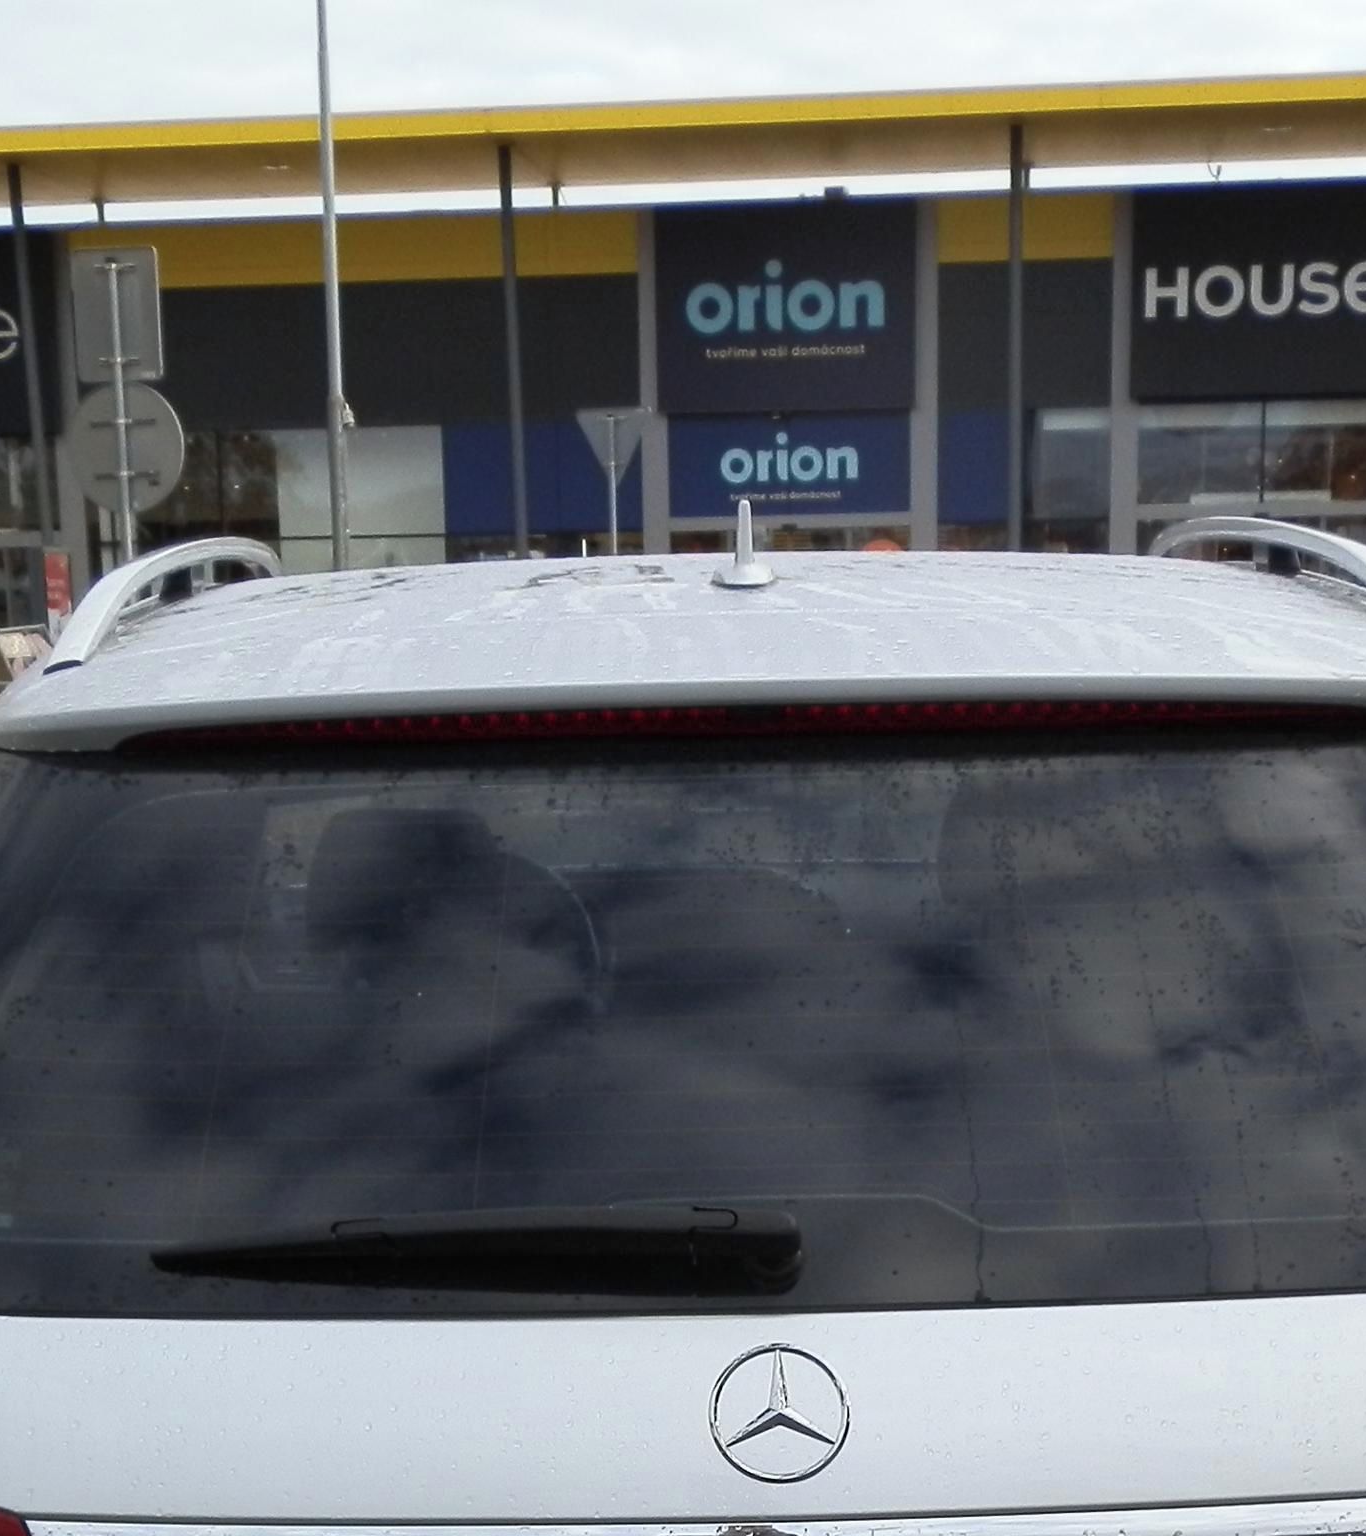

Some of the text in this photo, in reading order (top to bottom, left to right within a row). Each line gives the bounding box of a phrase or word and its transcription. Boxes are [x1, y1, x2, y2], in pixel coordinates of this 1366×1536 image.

[685, 258, 886, 335] orion
[705, 343, 866, 359] tvoříme vaši domácnost
[719, 431, 860, 484] orion
